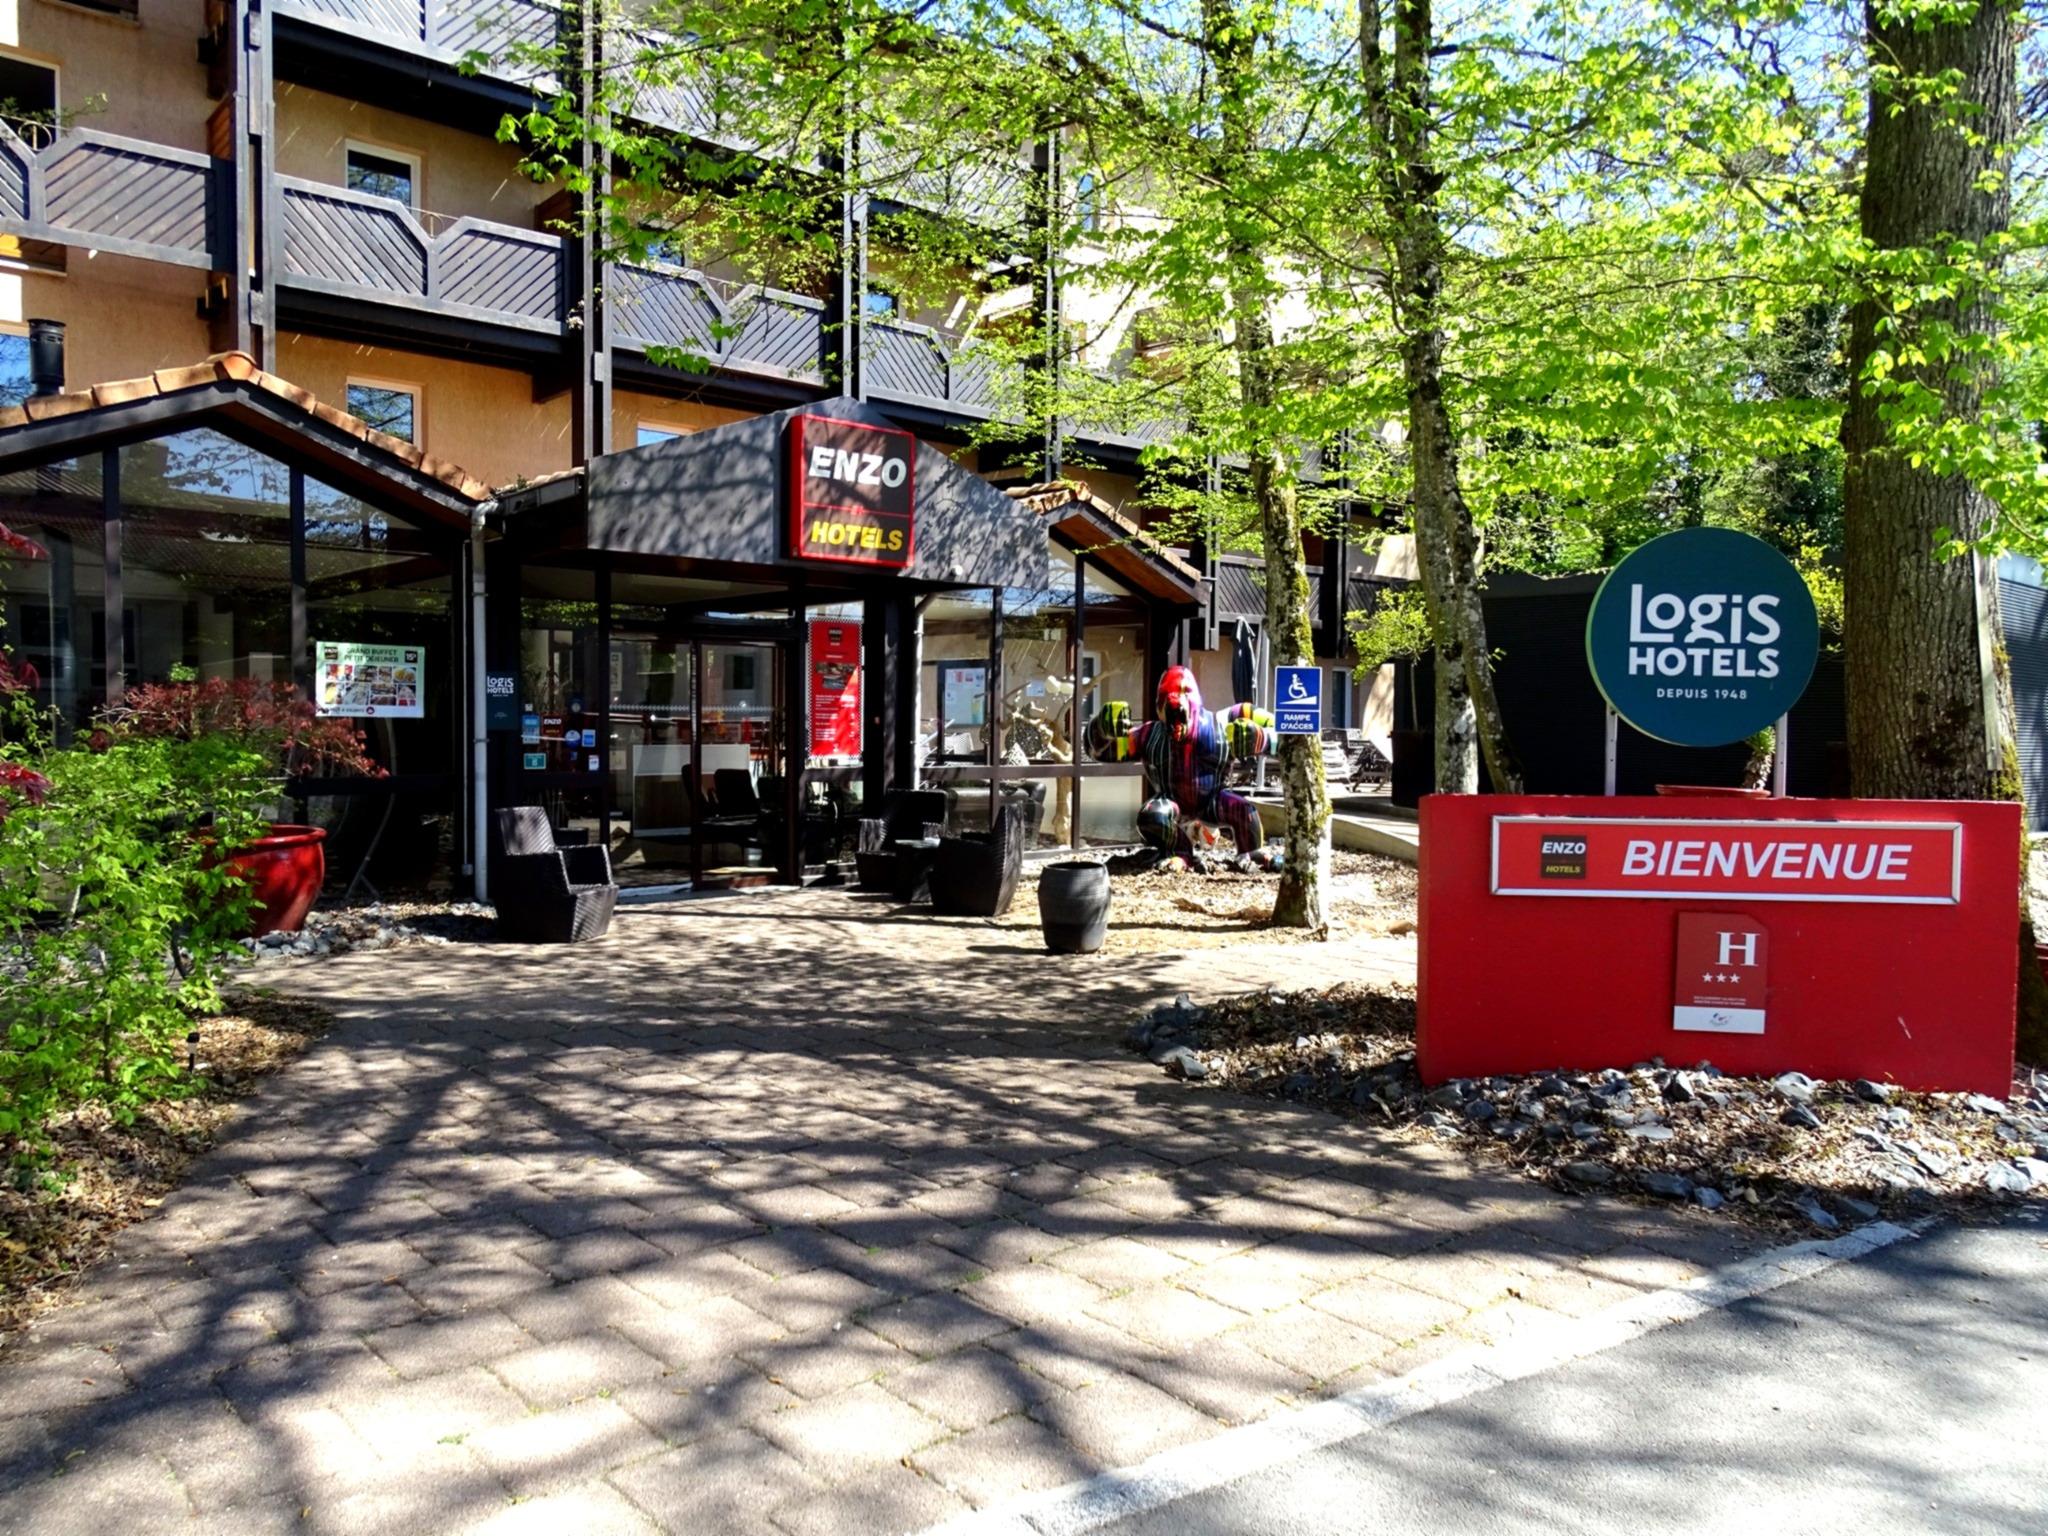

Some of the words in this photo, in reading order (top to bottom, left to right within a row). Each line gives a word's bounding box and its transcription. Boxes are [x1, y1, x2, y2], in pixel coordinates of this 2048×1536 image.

[808, 446, 907, 488] ENZO
[811, 521, 903, 551] HOTELS
[1628, 647, 1780, 678] HOTELS
[1656, 688, 1708, 699] DEPUIS
[1715, 689, 1747, 699] 1948
[1283, 713, 1311, 721] RAMPE
[1541, 841, 1586, 854] ENZO
[1621, 840, 1913, 881] BIENVENUE
[1545, 865, 1581, 873] HOTELS
[1715, 931, 1760, 966] H
